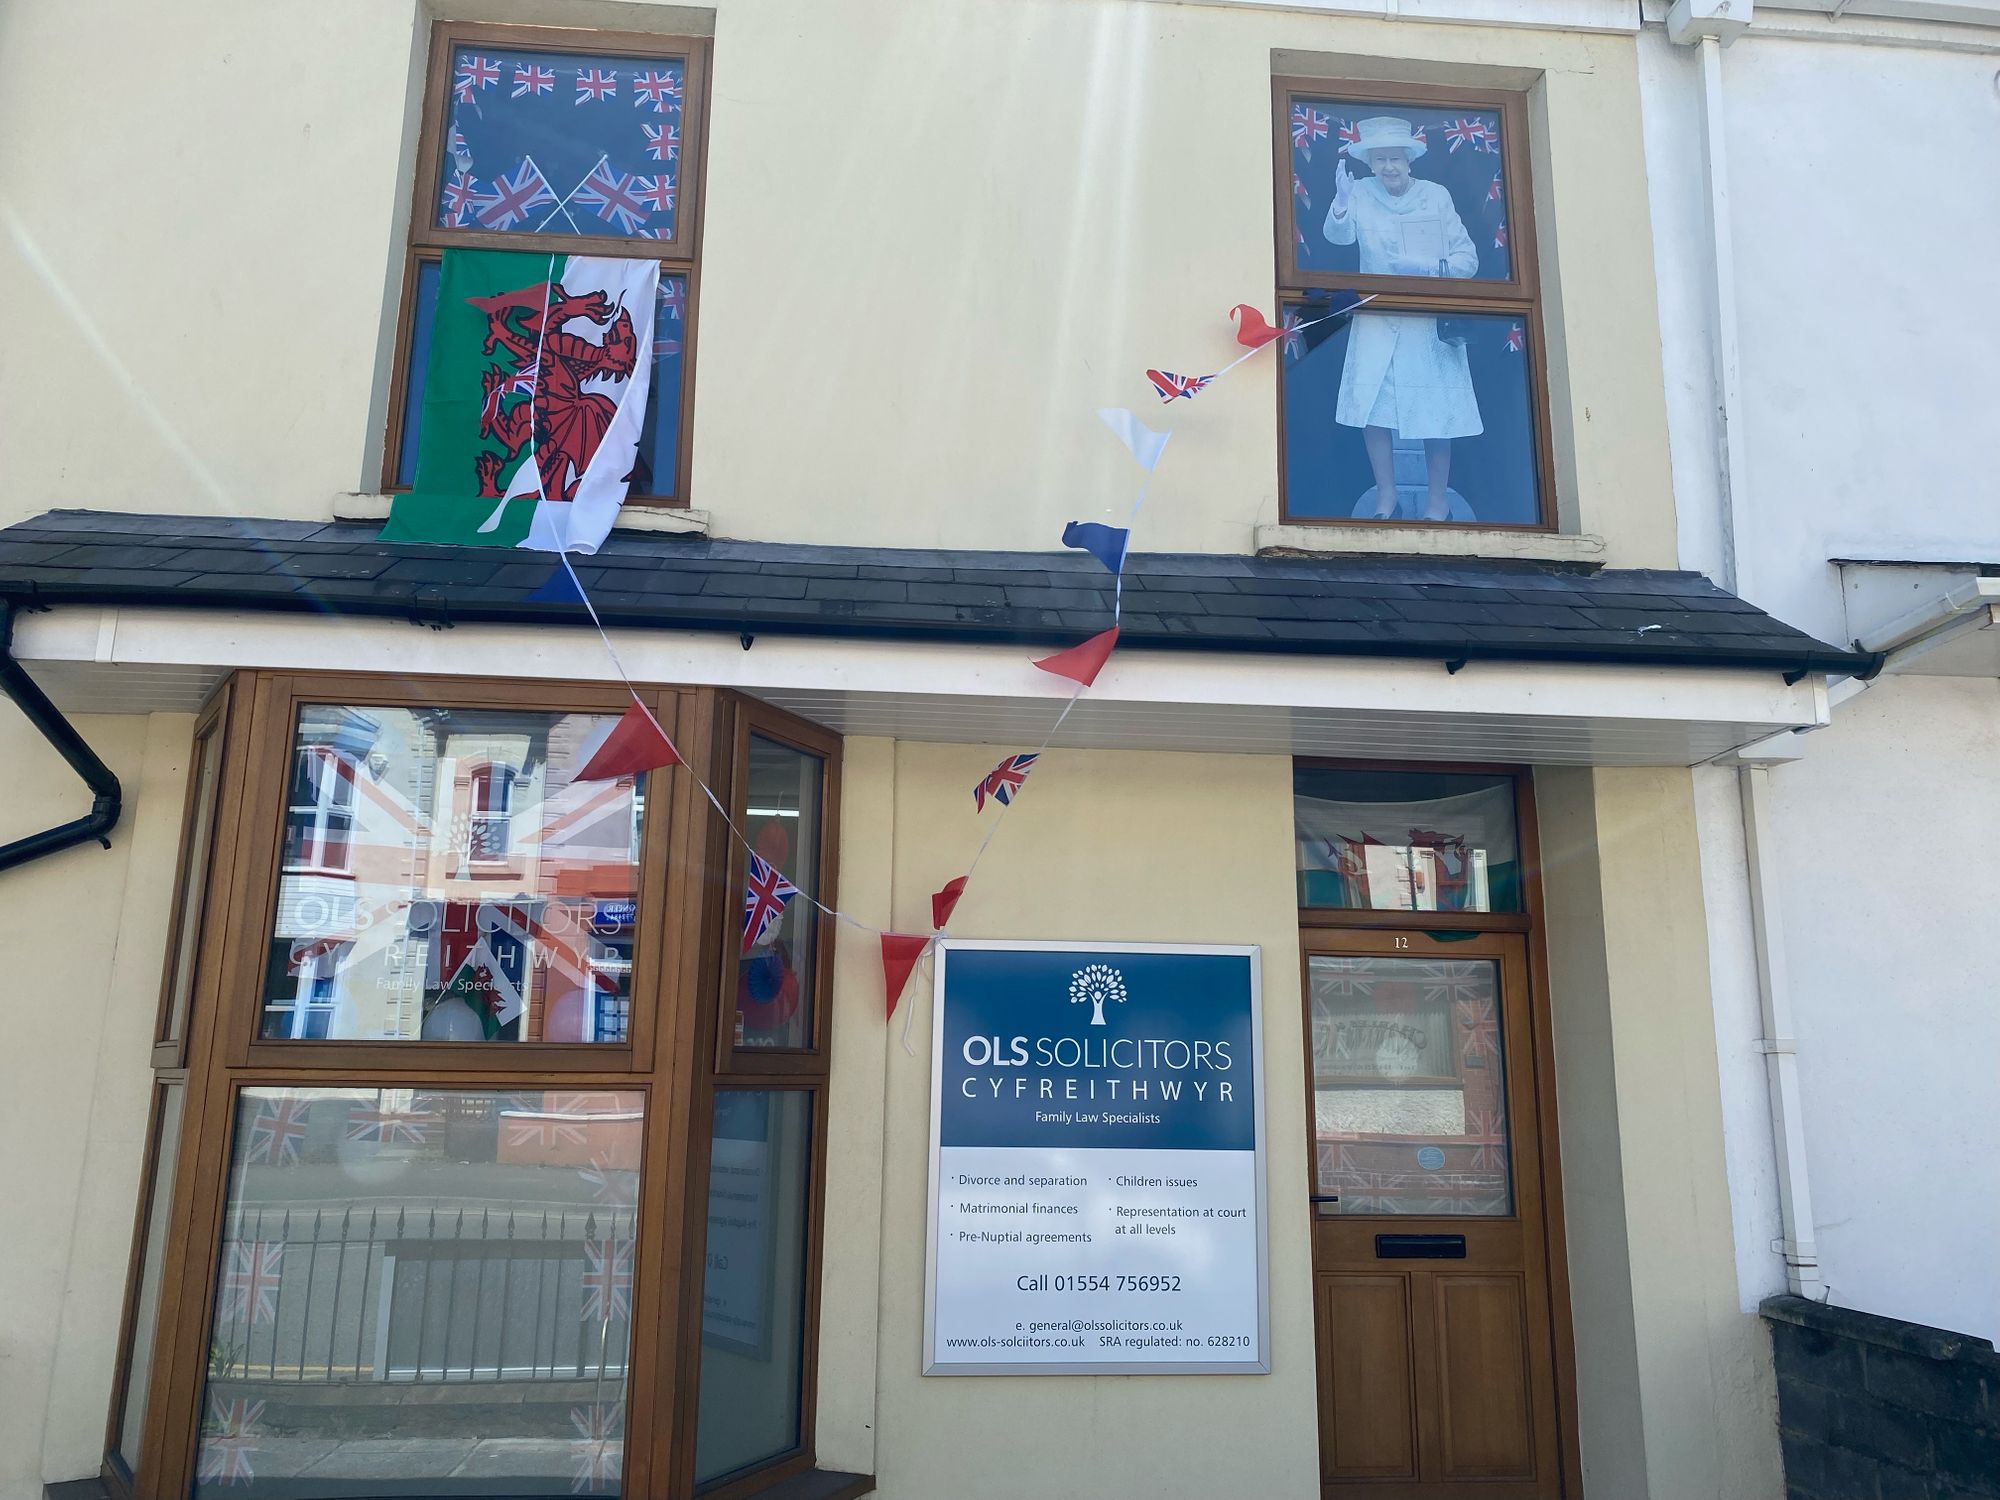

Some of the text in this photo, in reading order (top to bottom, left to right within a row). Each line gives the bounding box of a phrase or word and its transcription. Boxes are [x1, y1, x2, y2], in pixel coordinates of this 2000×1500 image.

[1394, 936, 1408, 949] 12
[963, 1035, 1233, 1071] OLS SOLICITORS
[961, 1077, 1234, 1102] CYFREITHWYR
[1035, 1111, 1161, 1126] Family Law Specialists
[959, 1174, 1088, 1189] Divorce and separation
[1116, 1175, 1198, 1187] Children issues
[960, 1202, 1078, 1214] Matrimonial finances
[1116, 1206, 1247, 1219] Representation at court
[1115, 1223, 1176, 1235] at all levels
[959, 1231, 1092, 1246] Pre-Nuptial agreements
[1017, 1274, 1182, 1292] Call 01554 756952
[1015, 1319, 1183, 1334] e. general@olssolicitors.co.uk
[946, 1336, 1250, 1350] www.ols-solciitors.co.uk SRA regulated: no. 628210
